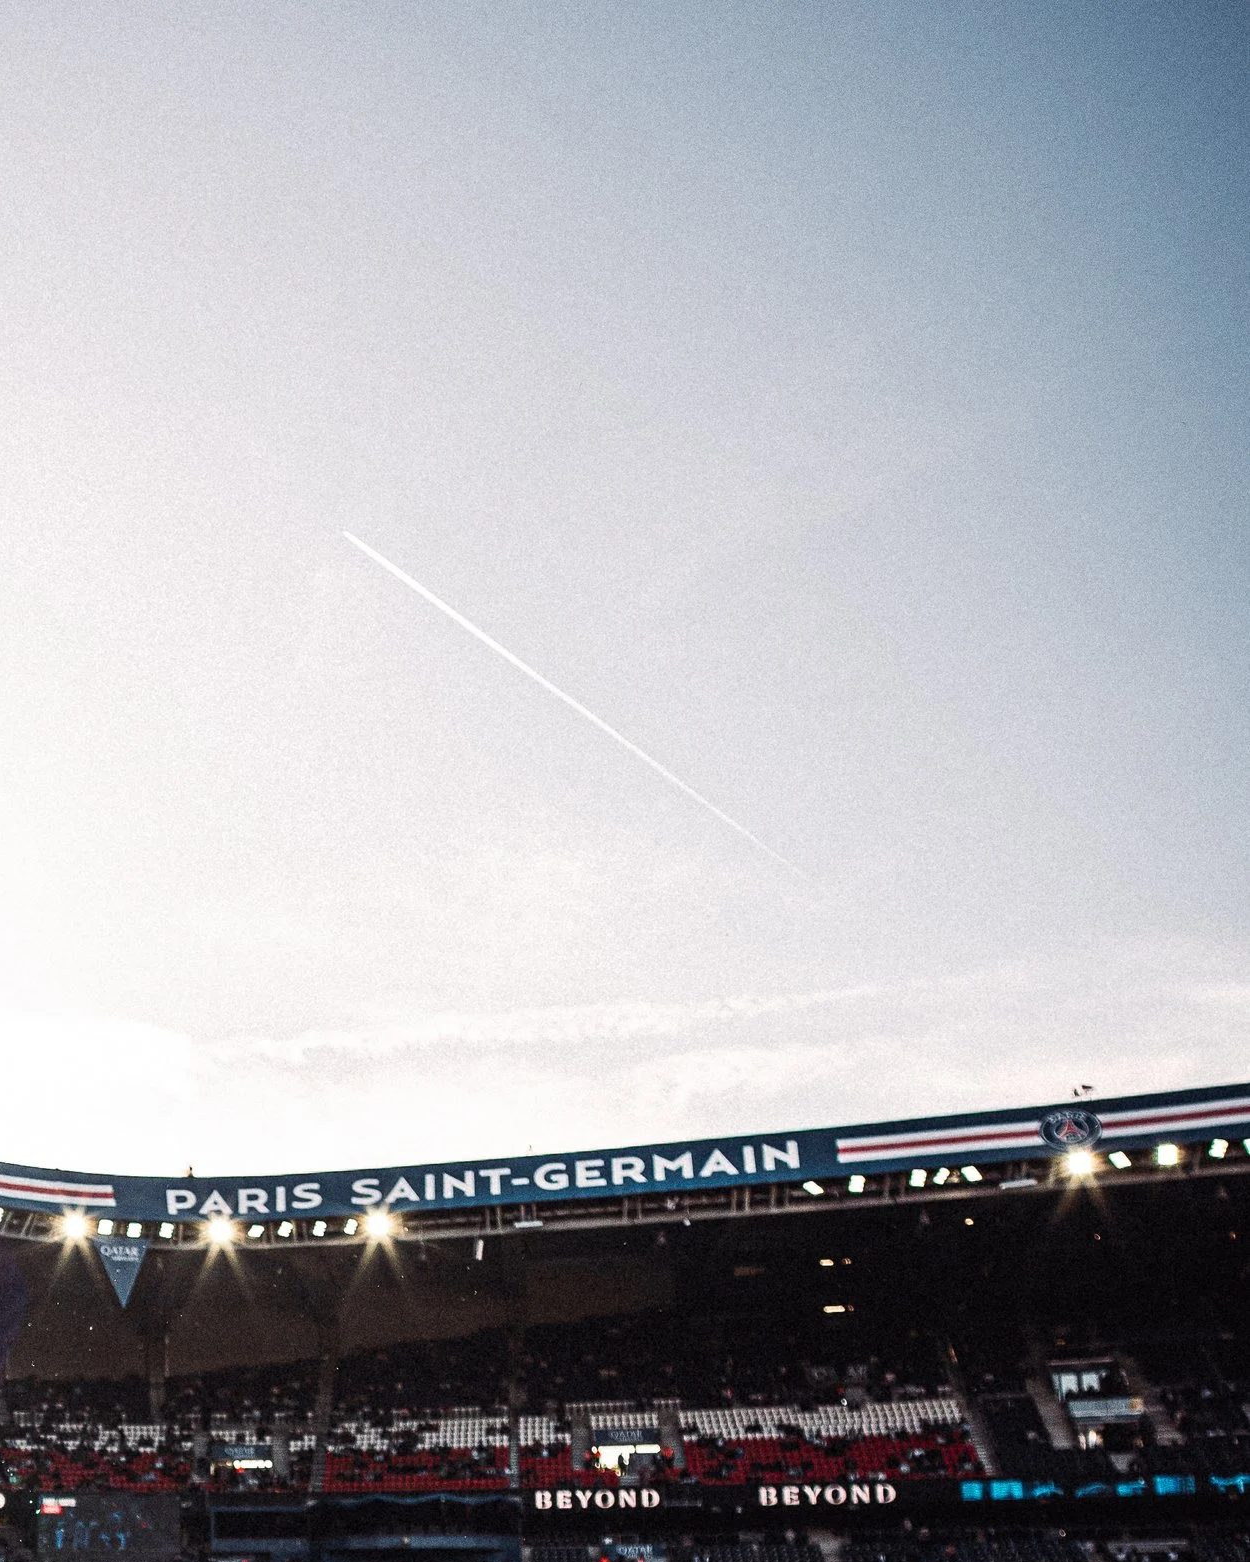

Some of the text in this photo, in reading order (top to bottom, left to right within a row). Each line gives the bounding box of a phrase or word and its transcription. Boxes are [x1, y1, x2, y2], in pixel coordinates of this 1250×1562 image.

[165, 1140, 801, 1216] PARIS SAINT-GERMAIN
[535, 1488, 661, 1510] BEYOND
[758, 1483, 898, 1507] BEYOND
